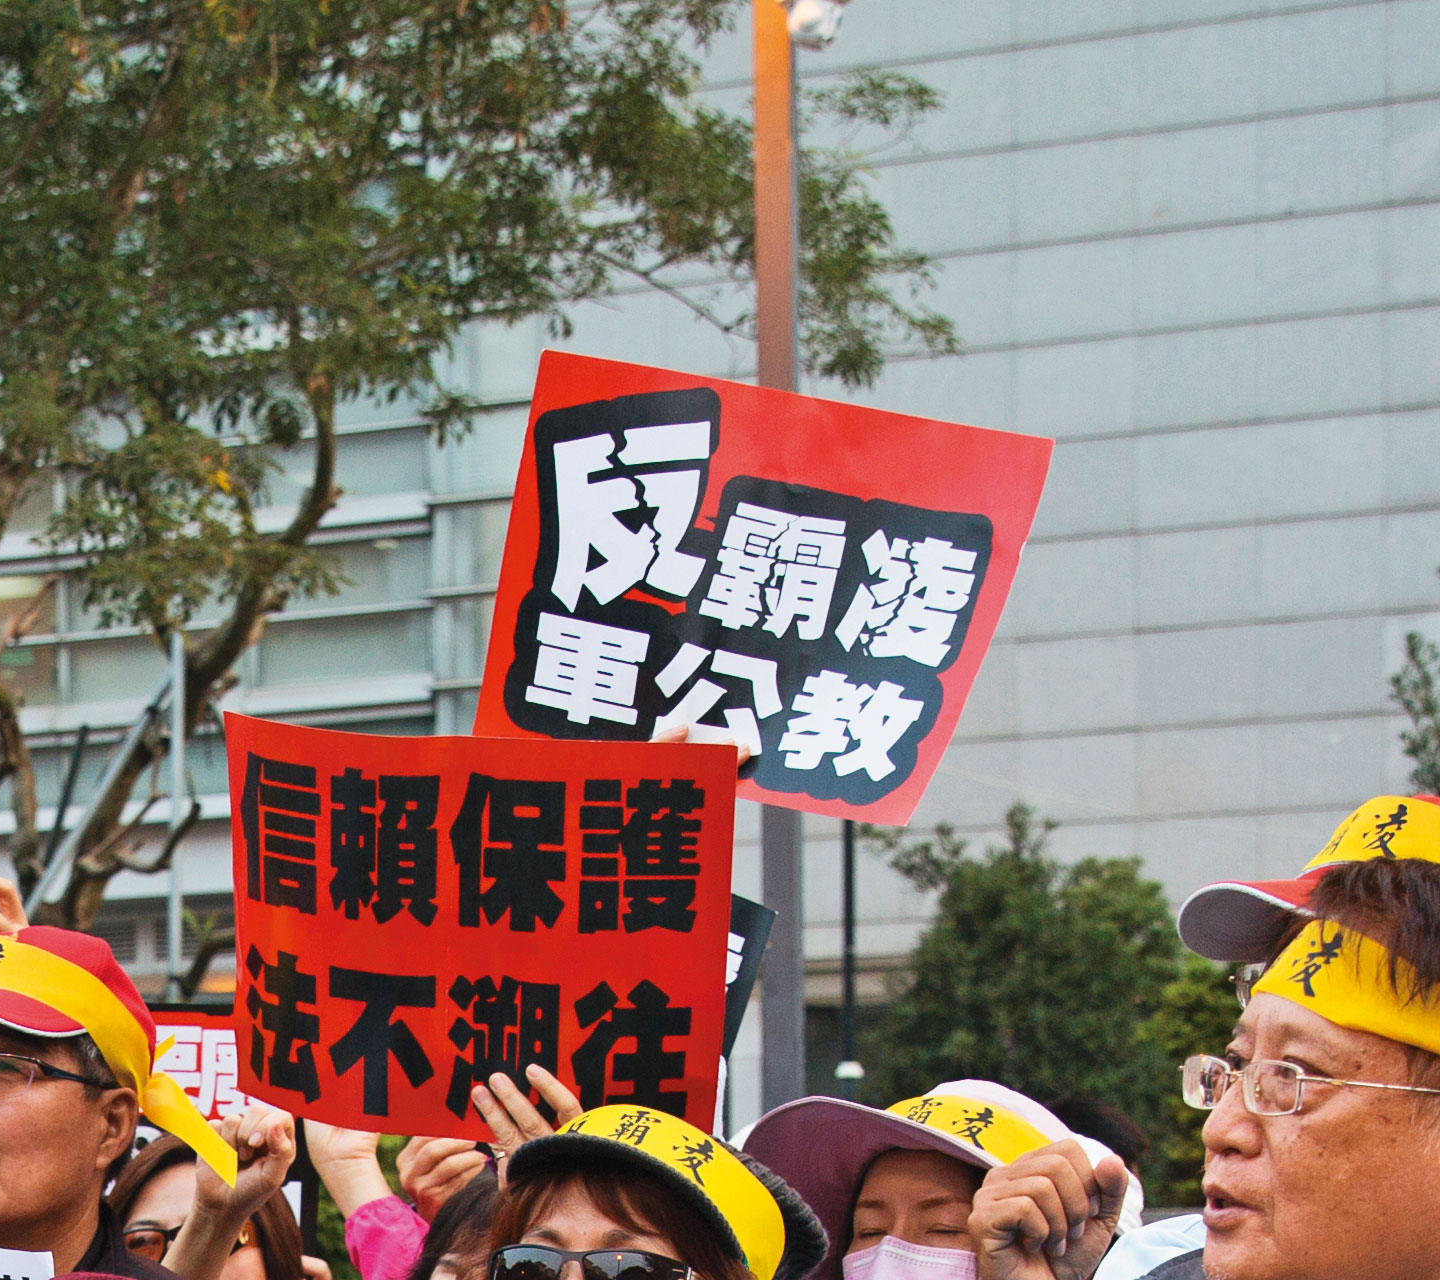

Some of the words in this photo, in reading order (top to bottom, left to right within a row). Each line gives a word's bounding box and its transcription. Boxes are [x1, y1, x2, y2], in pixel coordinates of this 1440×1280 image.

[552, 419, 979, 668] 反霸凌
[526, 611, 923, 783] 軍公教
[241, 751, 708, 935] 信賴保護
